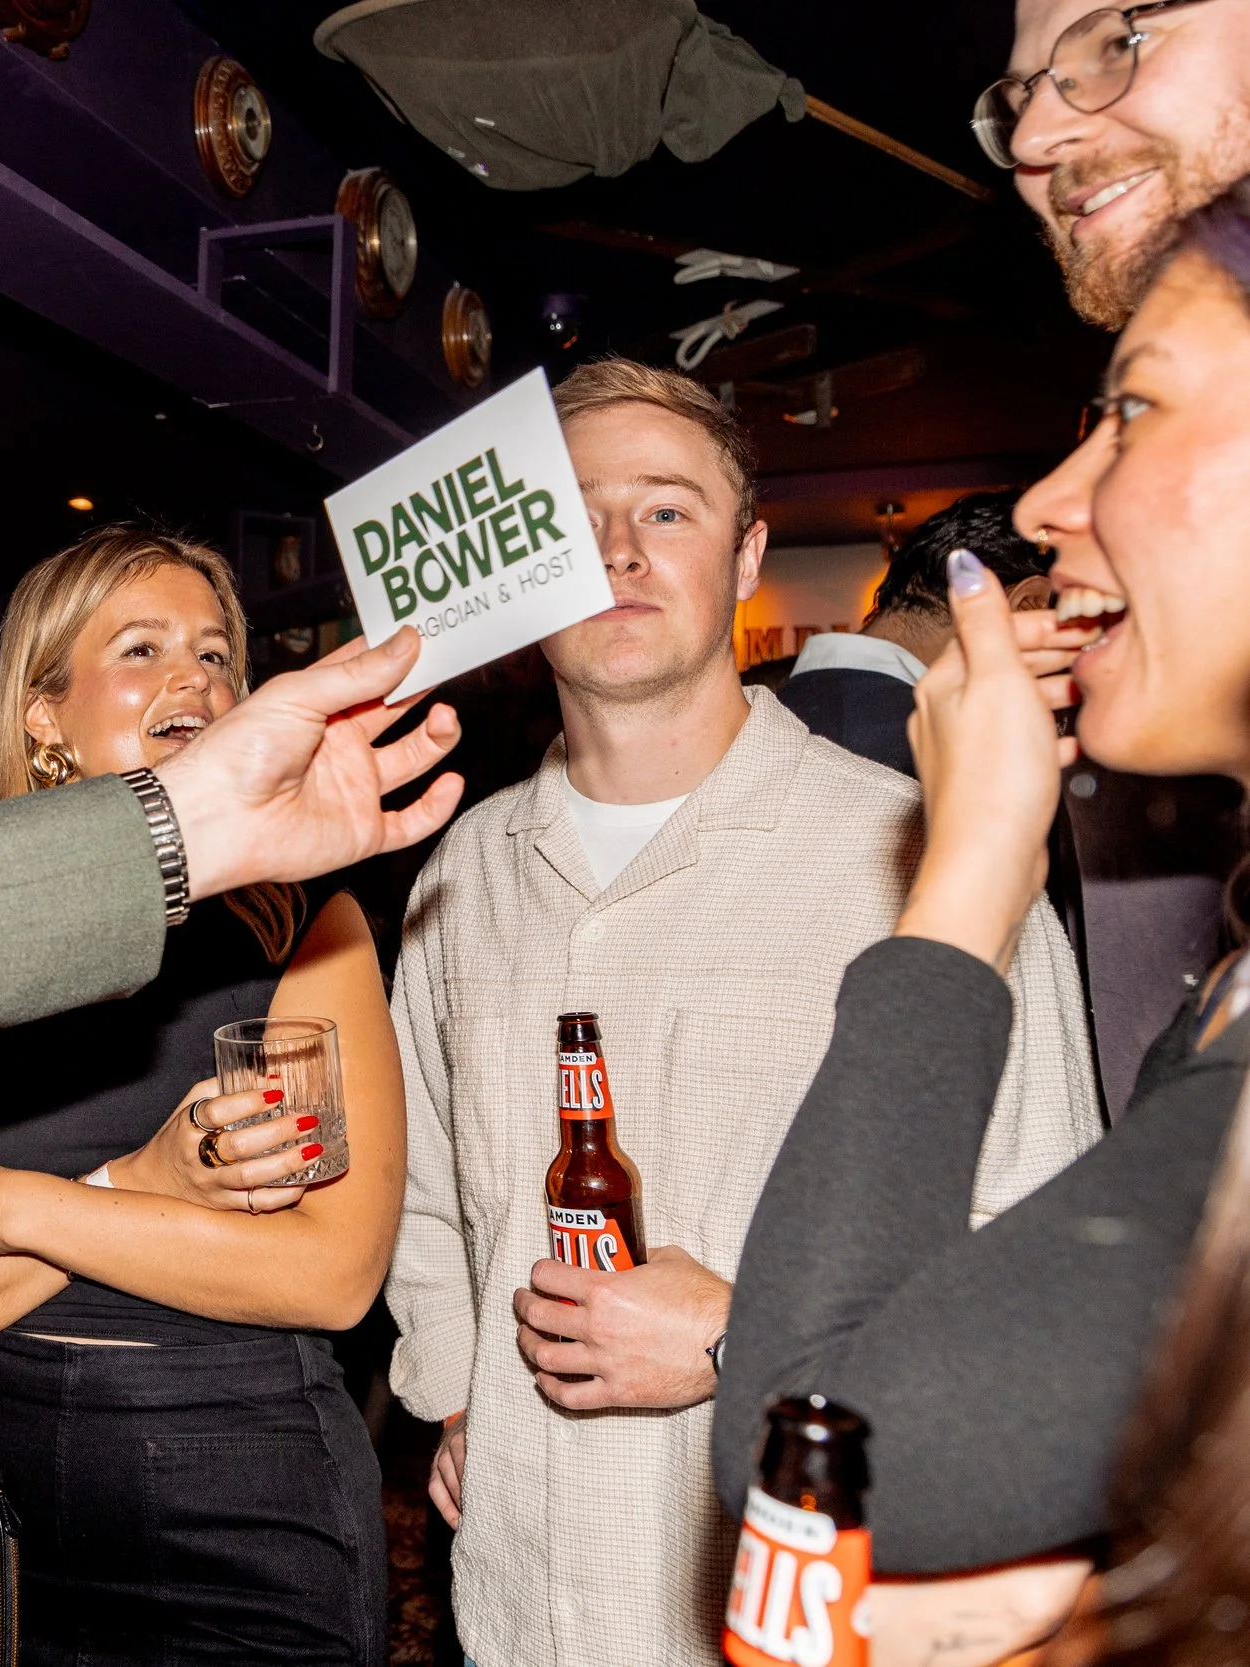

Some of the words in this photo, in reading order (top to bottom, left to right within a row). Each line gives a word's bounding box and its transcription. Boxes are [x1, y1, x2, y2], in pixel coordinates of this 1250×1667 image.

[353, 447, 526, 576] DANIEL
[381, 489, 566, 622] BOWER
[416, 592, 490, 641] AGICIAN
[497, 583, 512, 603] &
[517, 549, 575, 594] HOST
[560, 1055, 593, 1063] AMDEN
[560, 1069, 605, 1109] ELLS
[550, 1208, 598, 1226] AMDEN
[726, 1529, 843, 1667] ELLS
